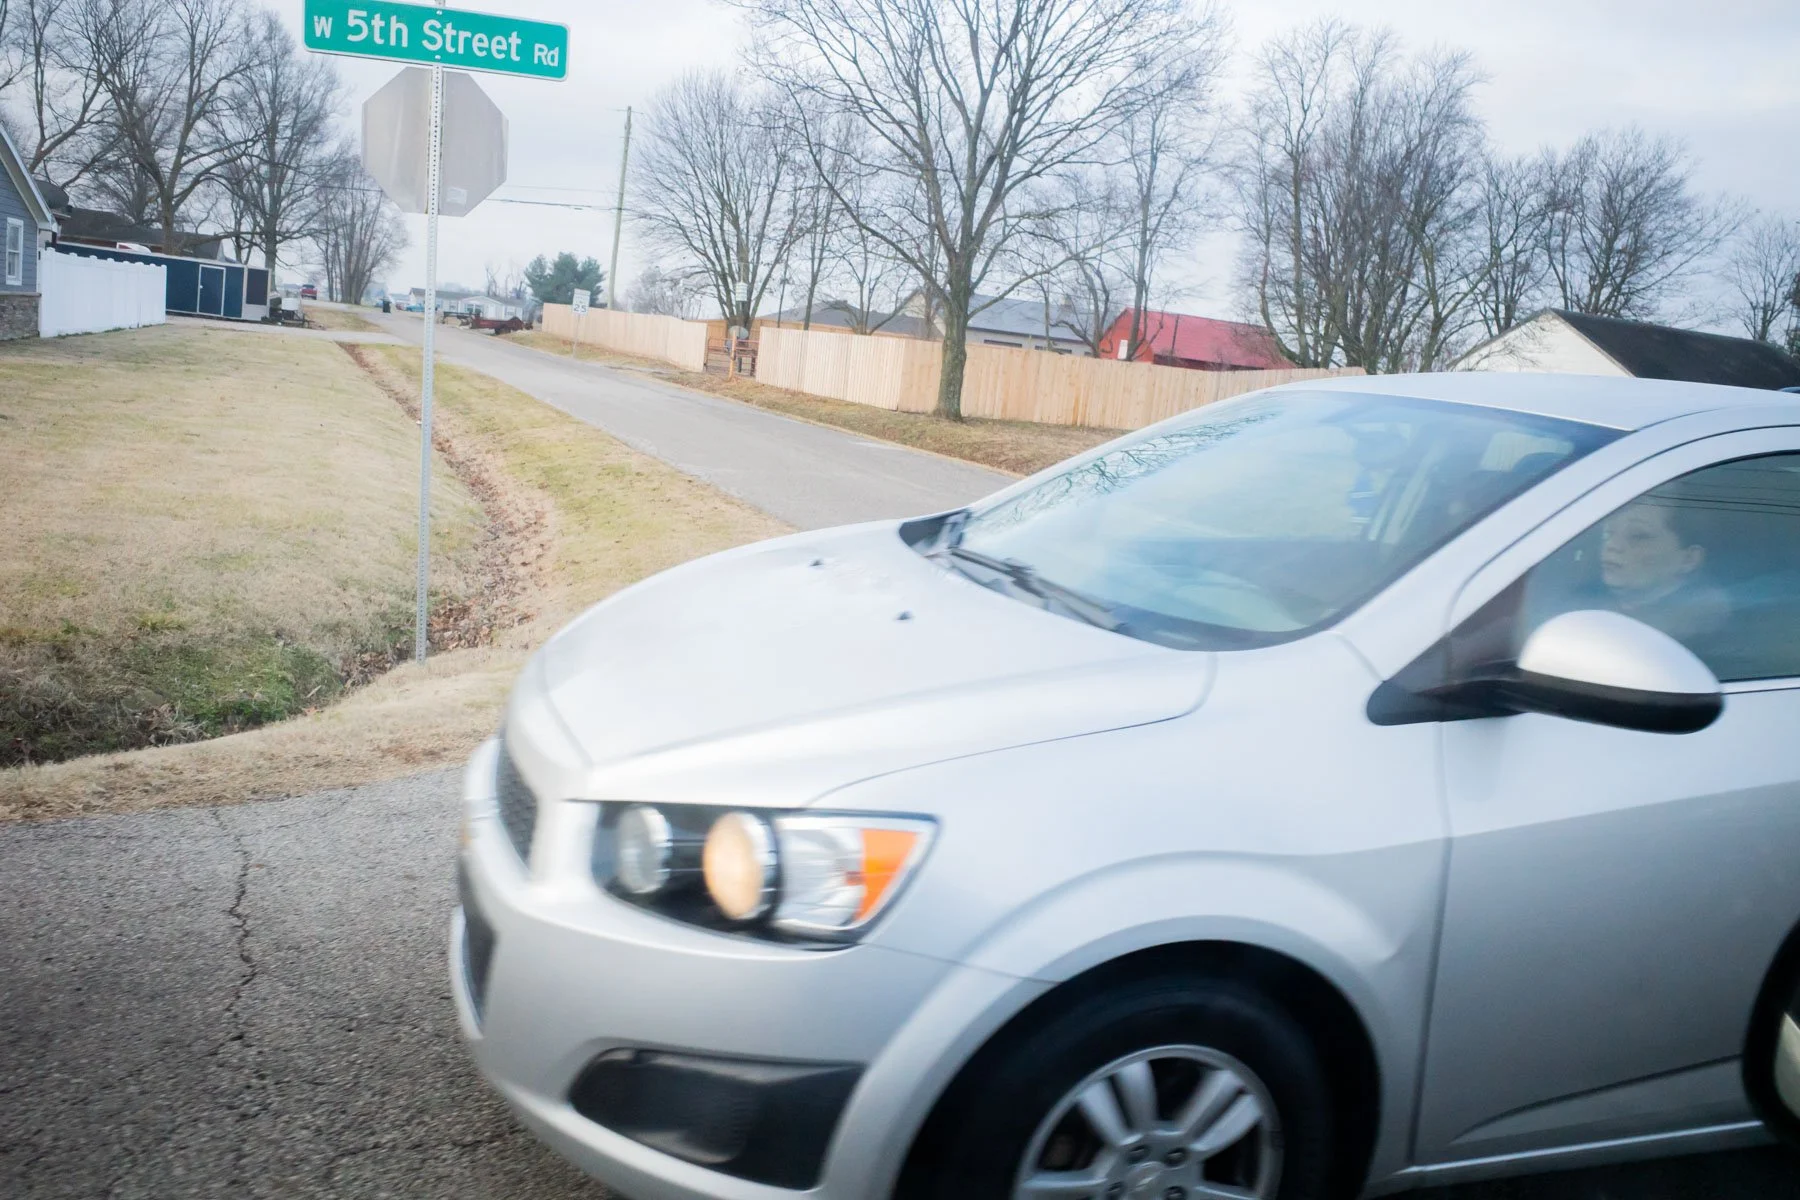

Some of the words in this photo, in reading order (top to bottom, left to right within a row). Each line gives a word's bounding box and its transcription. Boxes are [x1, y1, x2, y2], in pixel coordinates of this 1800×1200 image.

[313, 15, 333, 39] W
[347, 9, 408, 48] 5th
[421, 19, 521, 61] Street
[533, 43, 559, 67] Rd
[573, 304, 587, 313] 25
